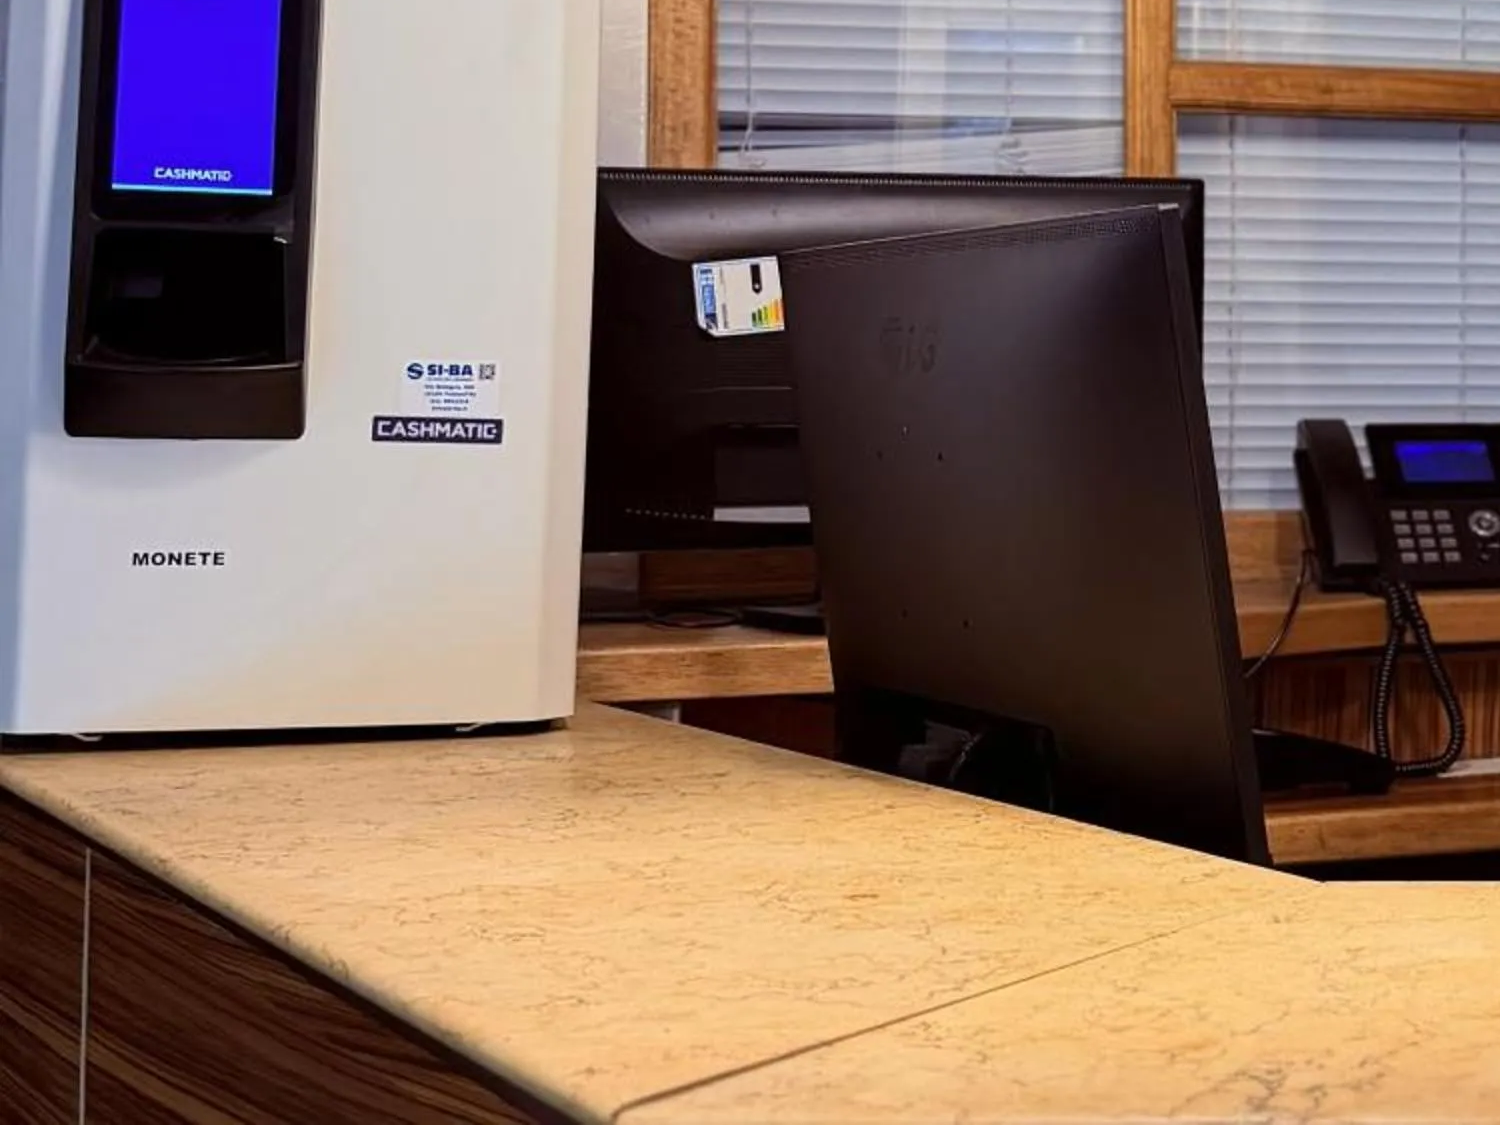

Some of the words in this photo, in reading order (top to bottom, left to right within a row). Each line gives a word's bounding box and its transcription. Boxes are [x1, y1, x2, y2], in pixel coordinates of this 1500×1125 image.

[427, 364, 473, 376] SI-BA
[377, 420, 497, 439] CASHMATIC
[132, 551, 226, 566] MONETE
